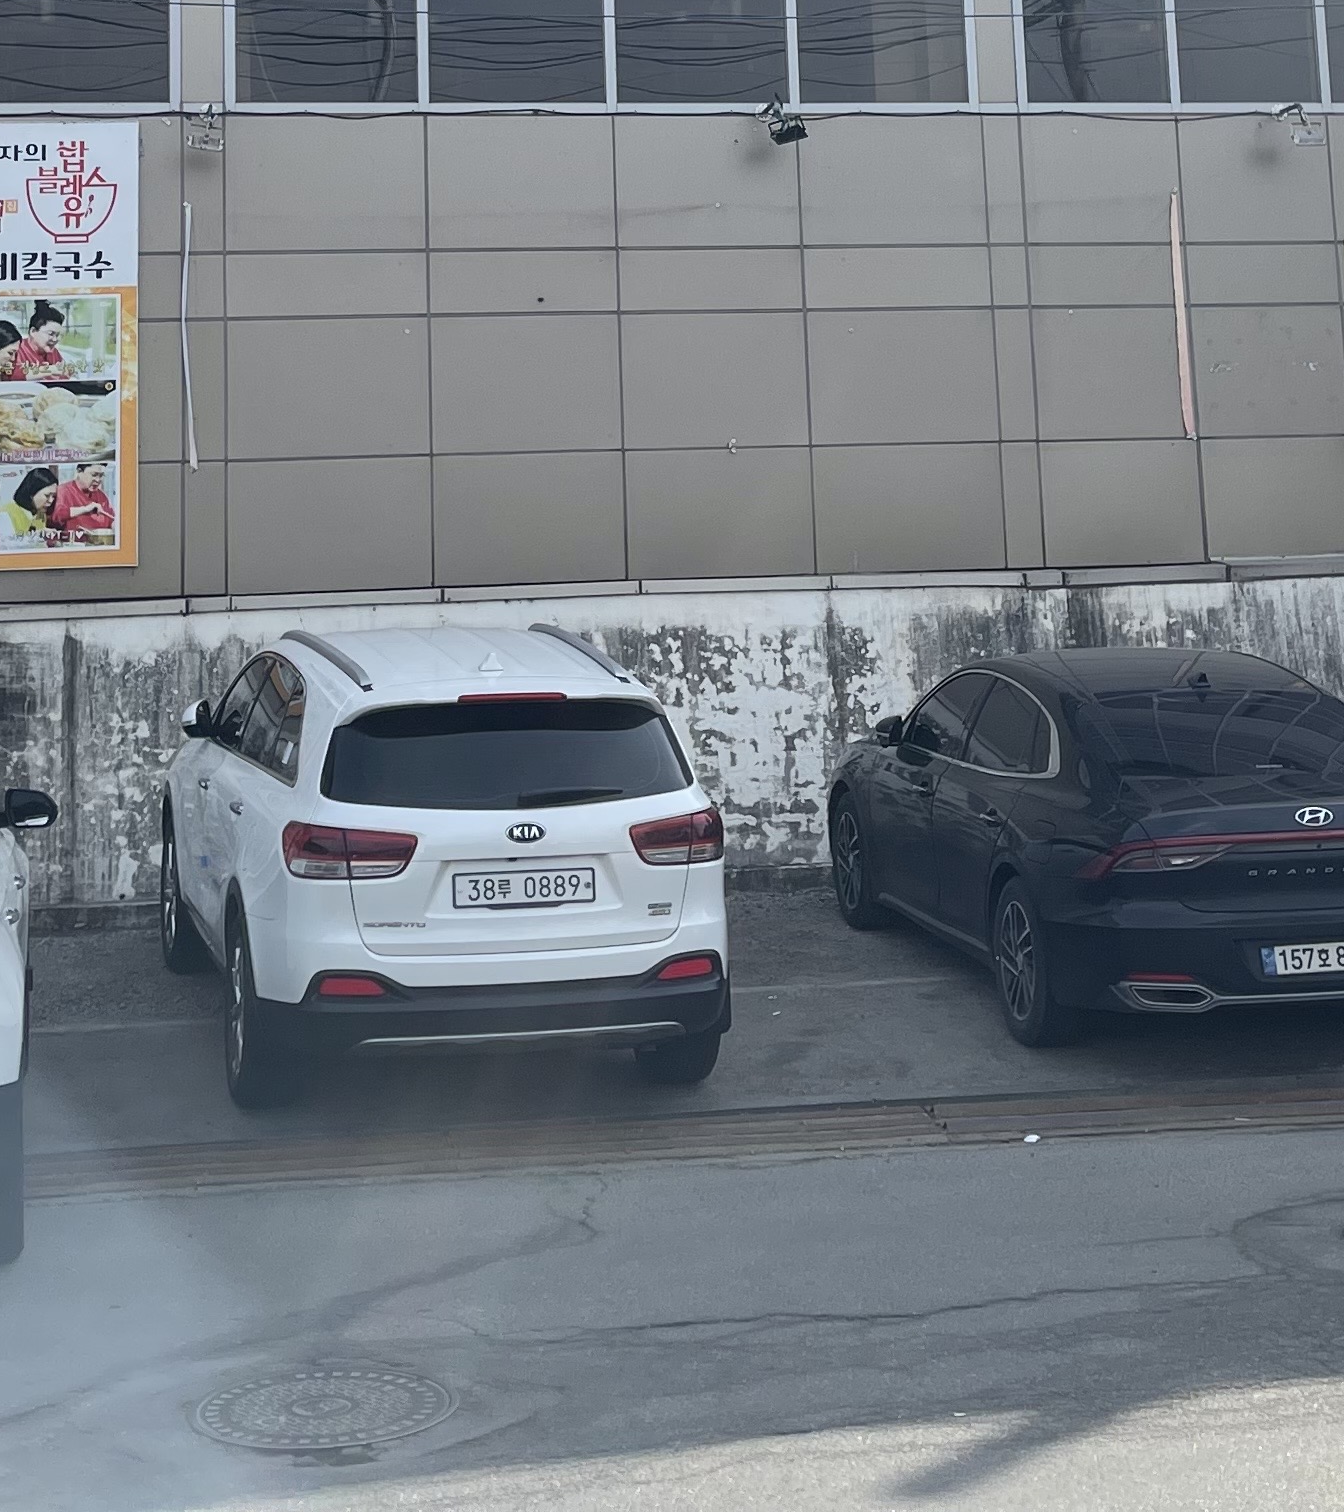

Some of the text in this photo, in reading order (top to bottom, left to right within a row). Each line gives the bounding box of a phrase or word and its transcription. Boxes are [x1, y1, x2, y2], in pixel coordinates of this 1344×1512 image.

[513, 825, 541, 840] KIA
[523, 876, 582, 899] 0889
[1277, 946, 1333, 972] 157호
